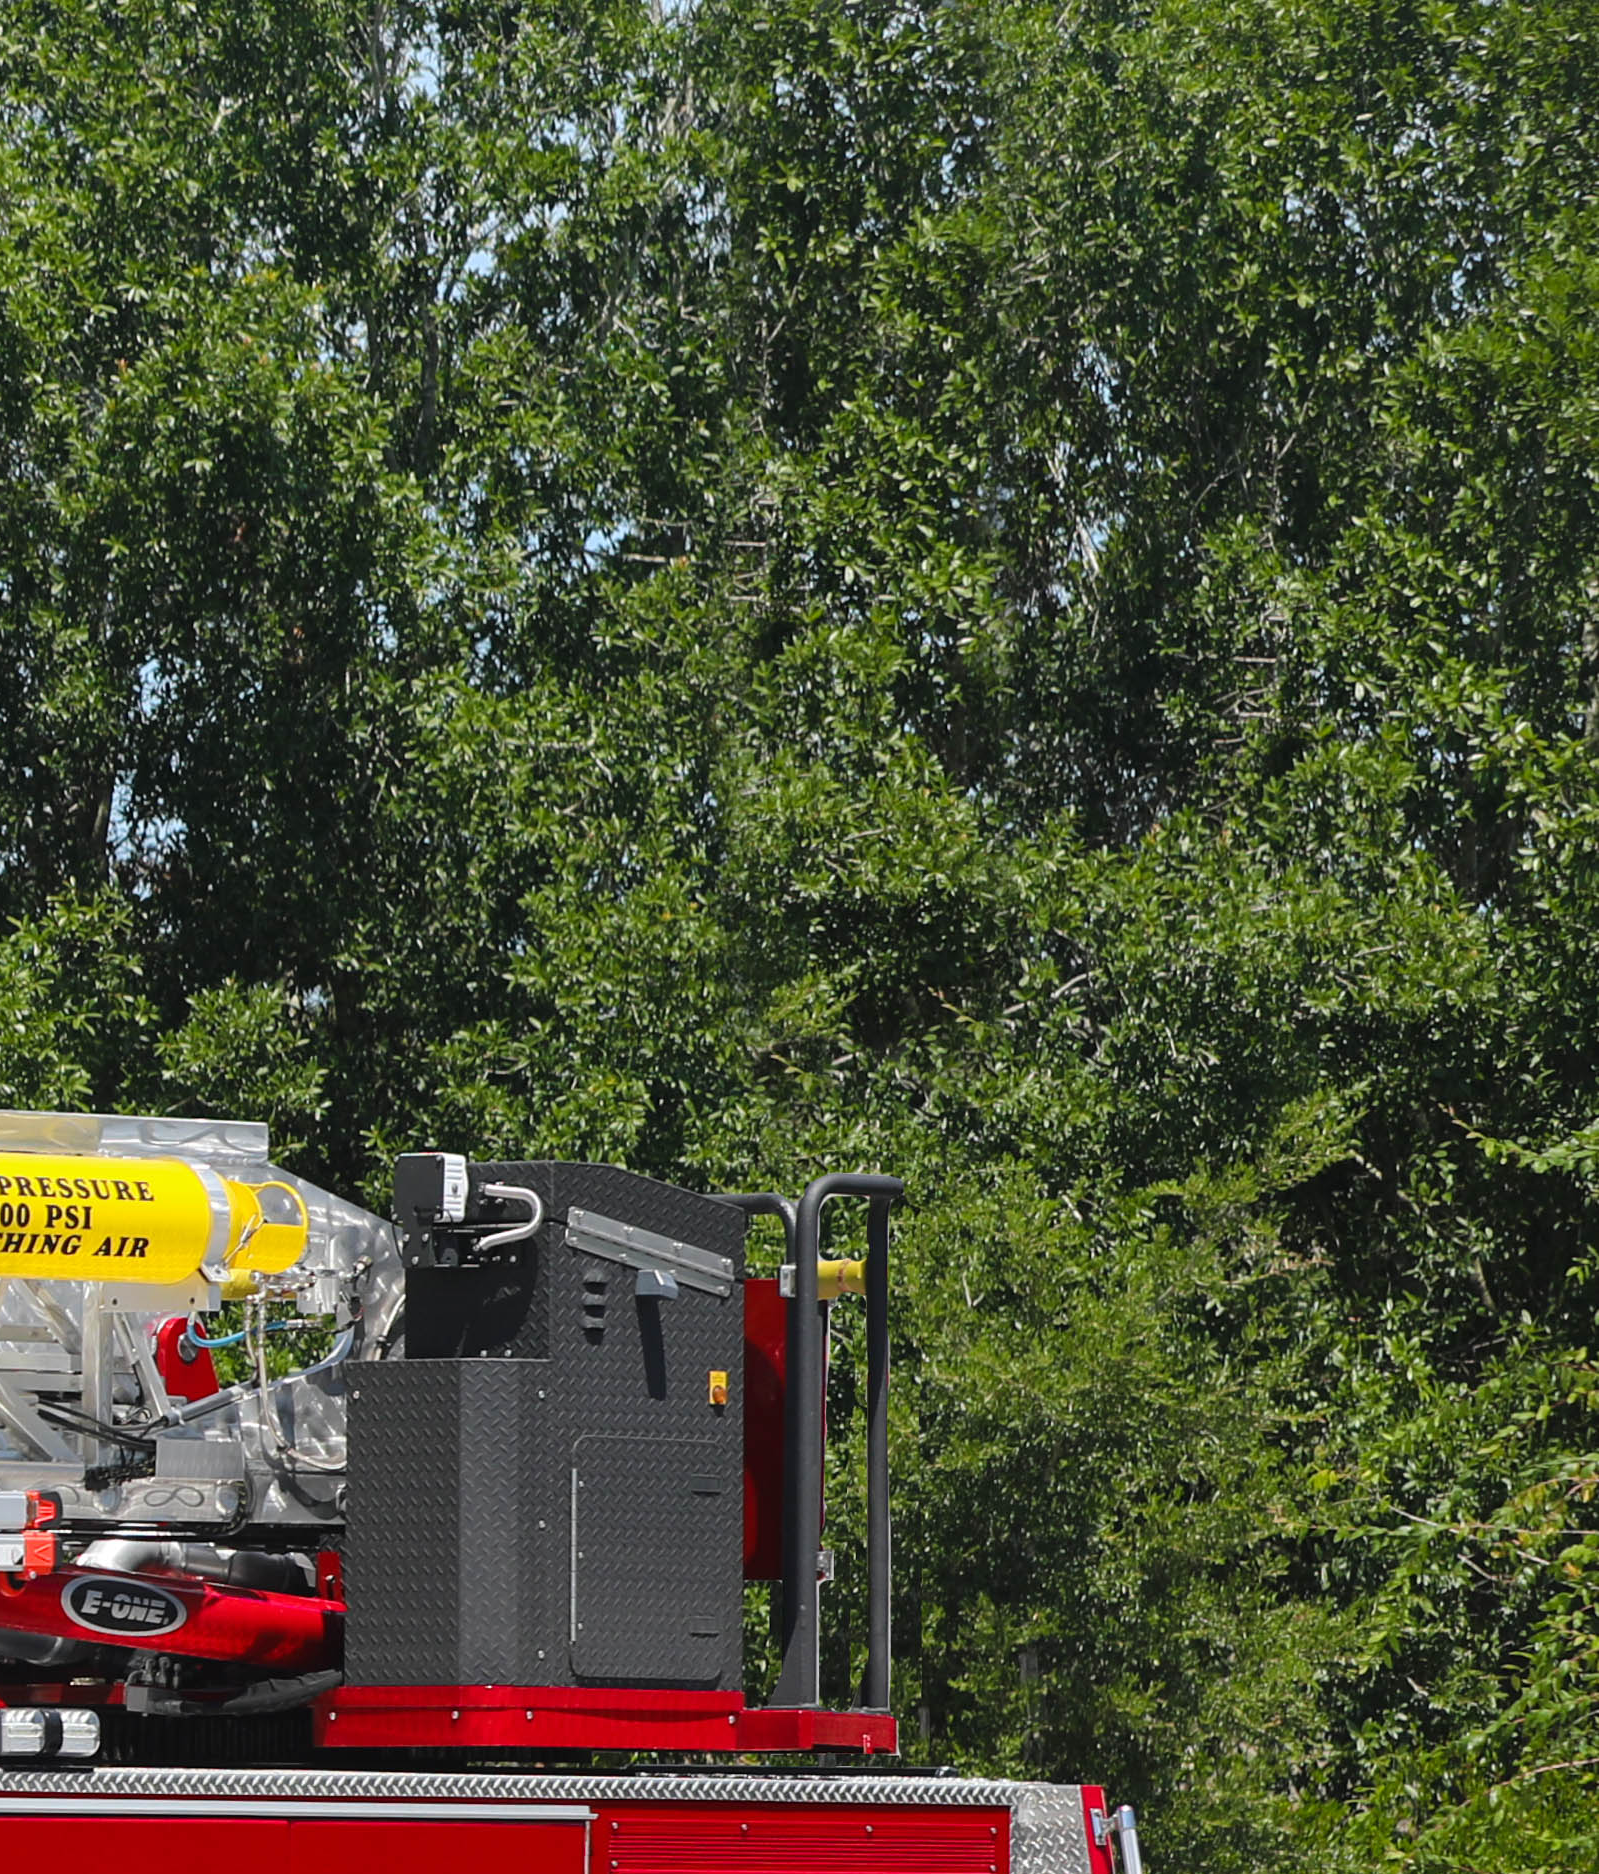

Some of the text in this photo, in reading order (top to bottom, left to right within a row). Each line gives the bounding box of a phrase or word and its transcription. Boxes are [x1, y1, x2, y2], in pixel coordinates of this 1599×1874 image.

[44, 1204, 93, 1230] PSI
[92, 1236, 150, 1258] AIR
[80, 1589, 167, 1625] E-ONE
